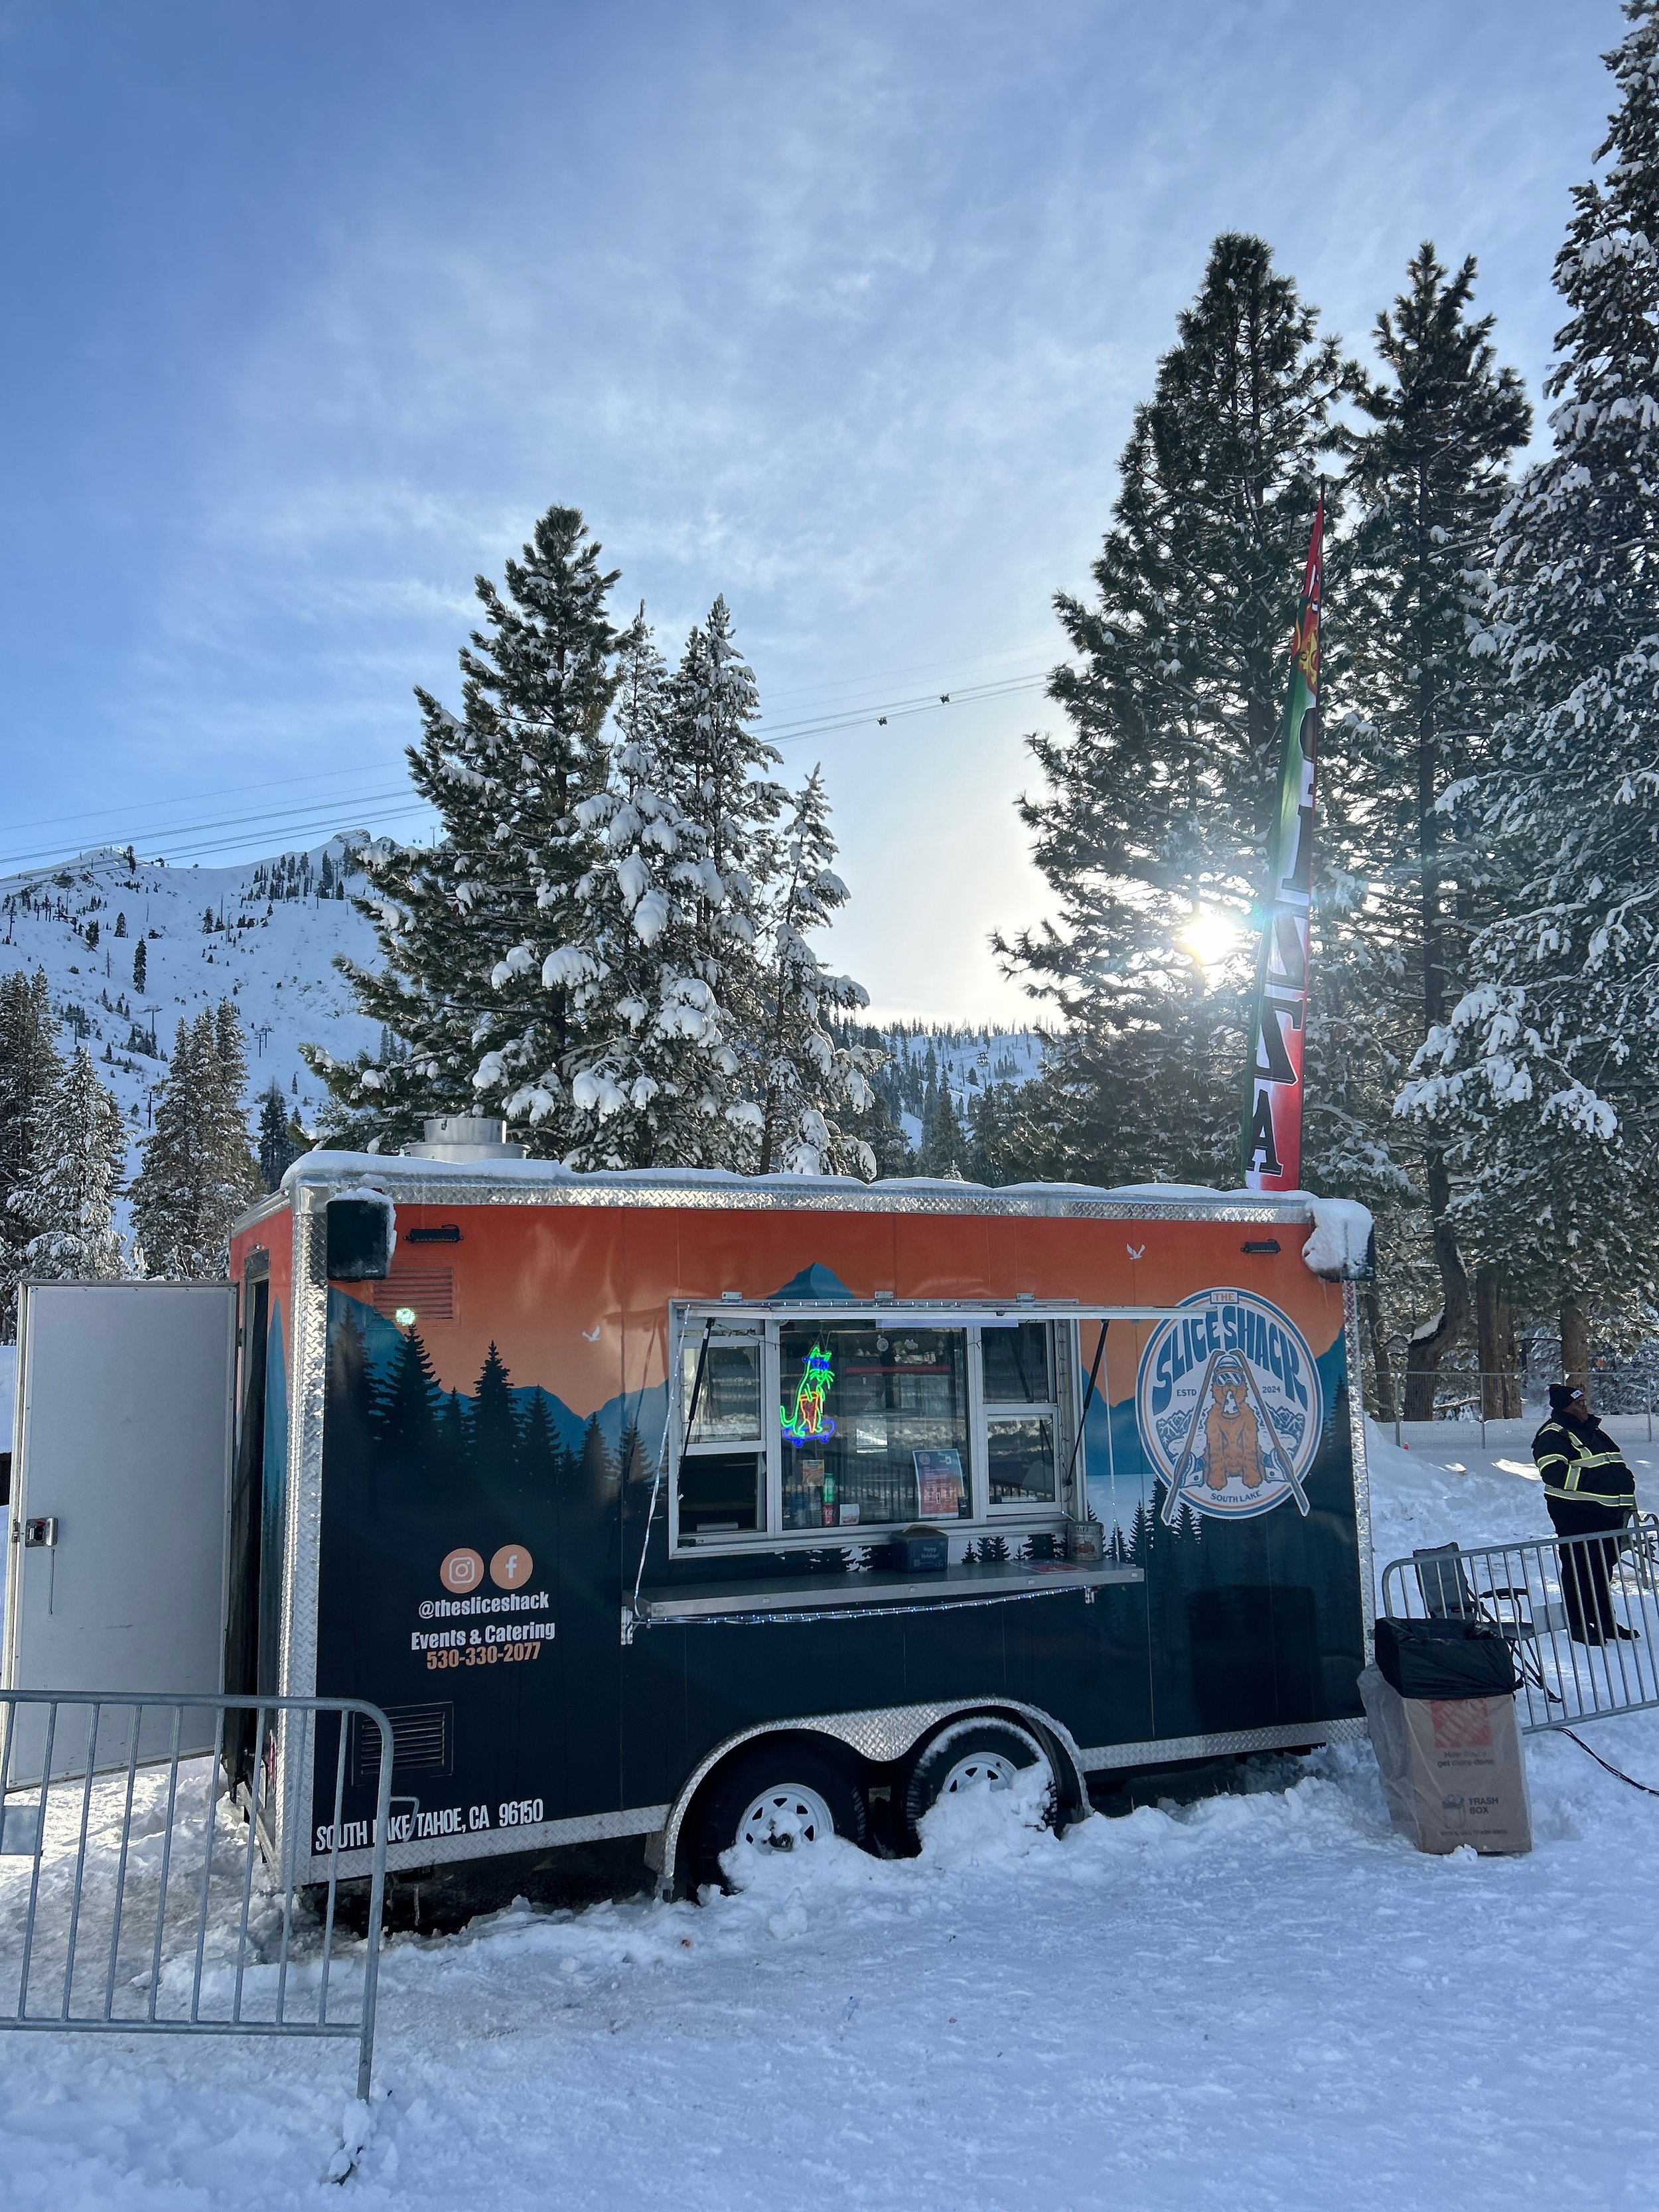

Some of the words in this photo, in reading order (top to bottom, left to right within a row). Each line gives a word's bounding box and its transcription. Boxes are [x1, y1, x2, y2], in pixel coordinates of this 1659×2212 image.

[1214, 1293, 1235, 1302] THE
[1151, 1311, 1222, 1416] SLICE
[1222, 1305, 1308, 1412] SHACK
[1210, 1493, 1238, 1503] SOUTH
[1239, 1490, 1262, 1502] LAKE
[418, 1591, 549, 1619] @thesliceshack
[411, 1629, 467, 1651] Events
[469, 1629, 482, 1645] &
[484, 1621, 555, 1643] Catering
[426, 1641, 541, 1670] 530-330-2077
[1468, 1797, 1499, 1805] TRASH
[1469, 1806, 1489, 1814] BOX
[315, 1820, 368, 1851] SOUTH
[416, 1807, 467, 1837] TAHOE,
[469, 1805, 490, 1830] CA
[498, 1798, 543, 1827] 96150
